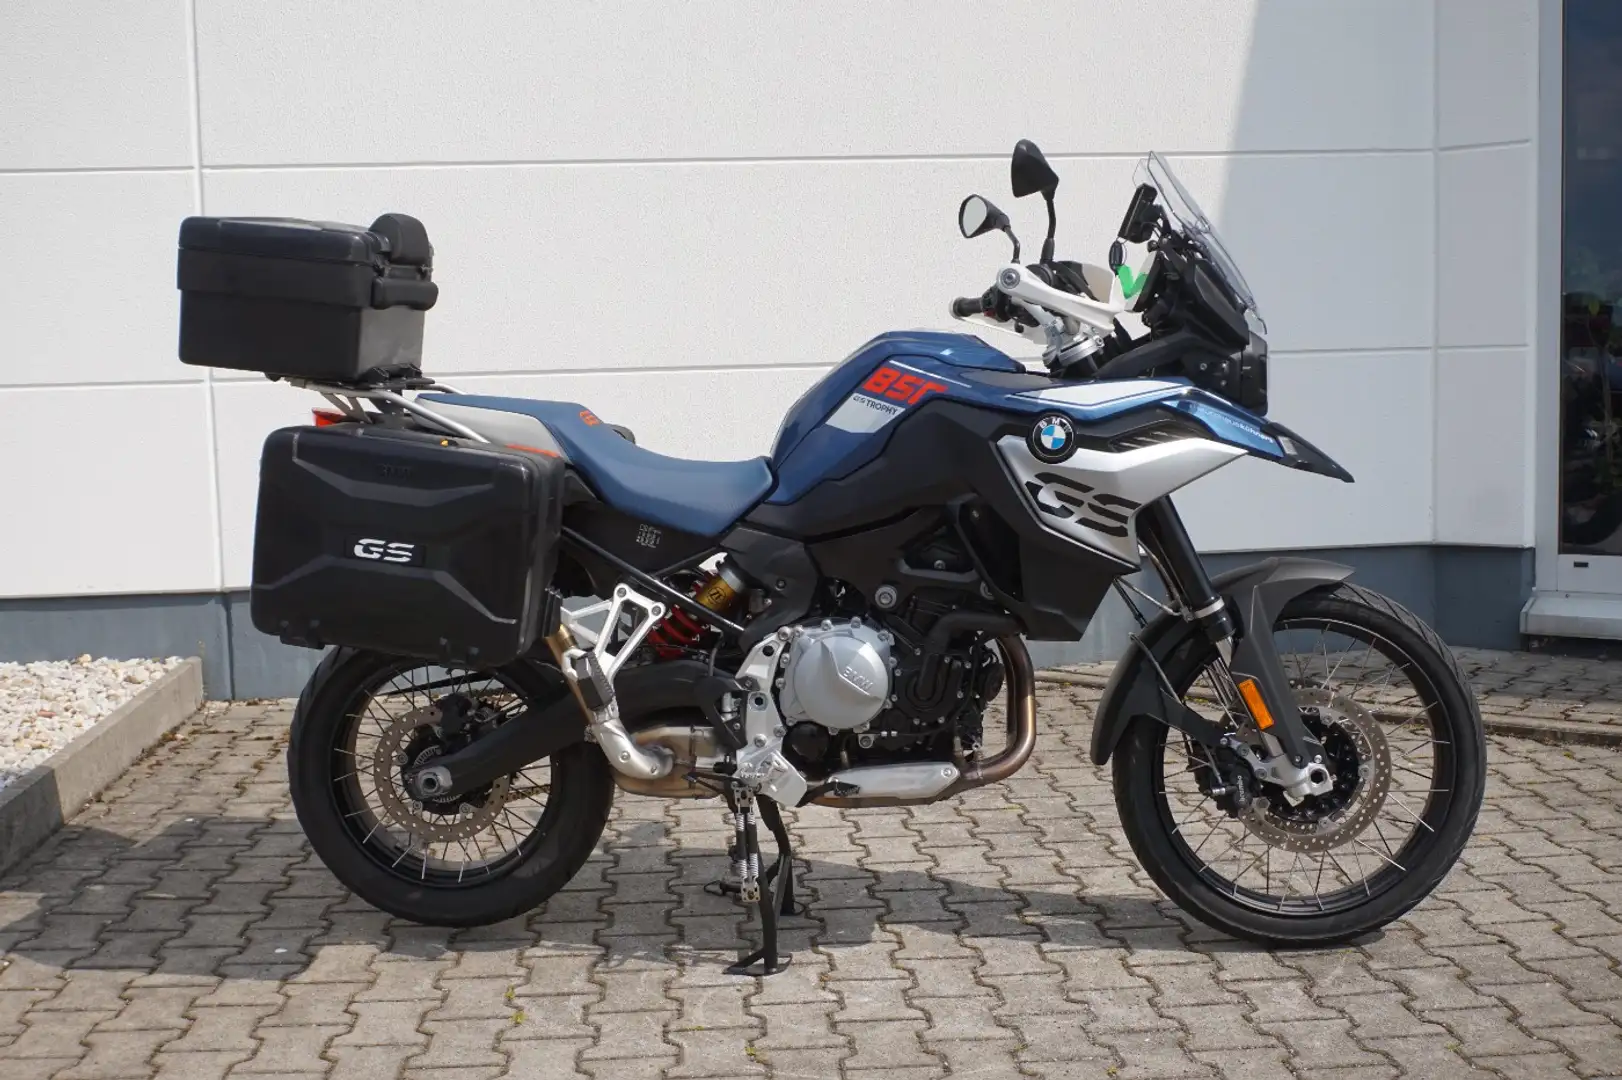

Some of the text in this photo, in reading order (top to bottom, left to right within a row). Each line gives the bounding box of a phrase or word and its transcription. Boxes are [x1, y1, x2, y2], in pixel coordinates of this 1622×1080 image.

[866, 398, 898, 415] TROPHY
[1039, 415, 1073, 433] BMW
[1025, 472, 1142, 537] GS
[354, 538, 415, 563] GS
